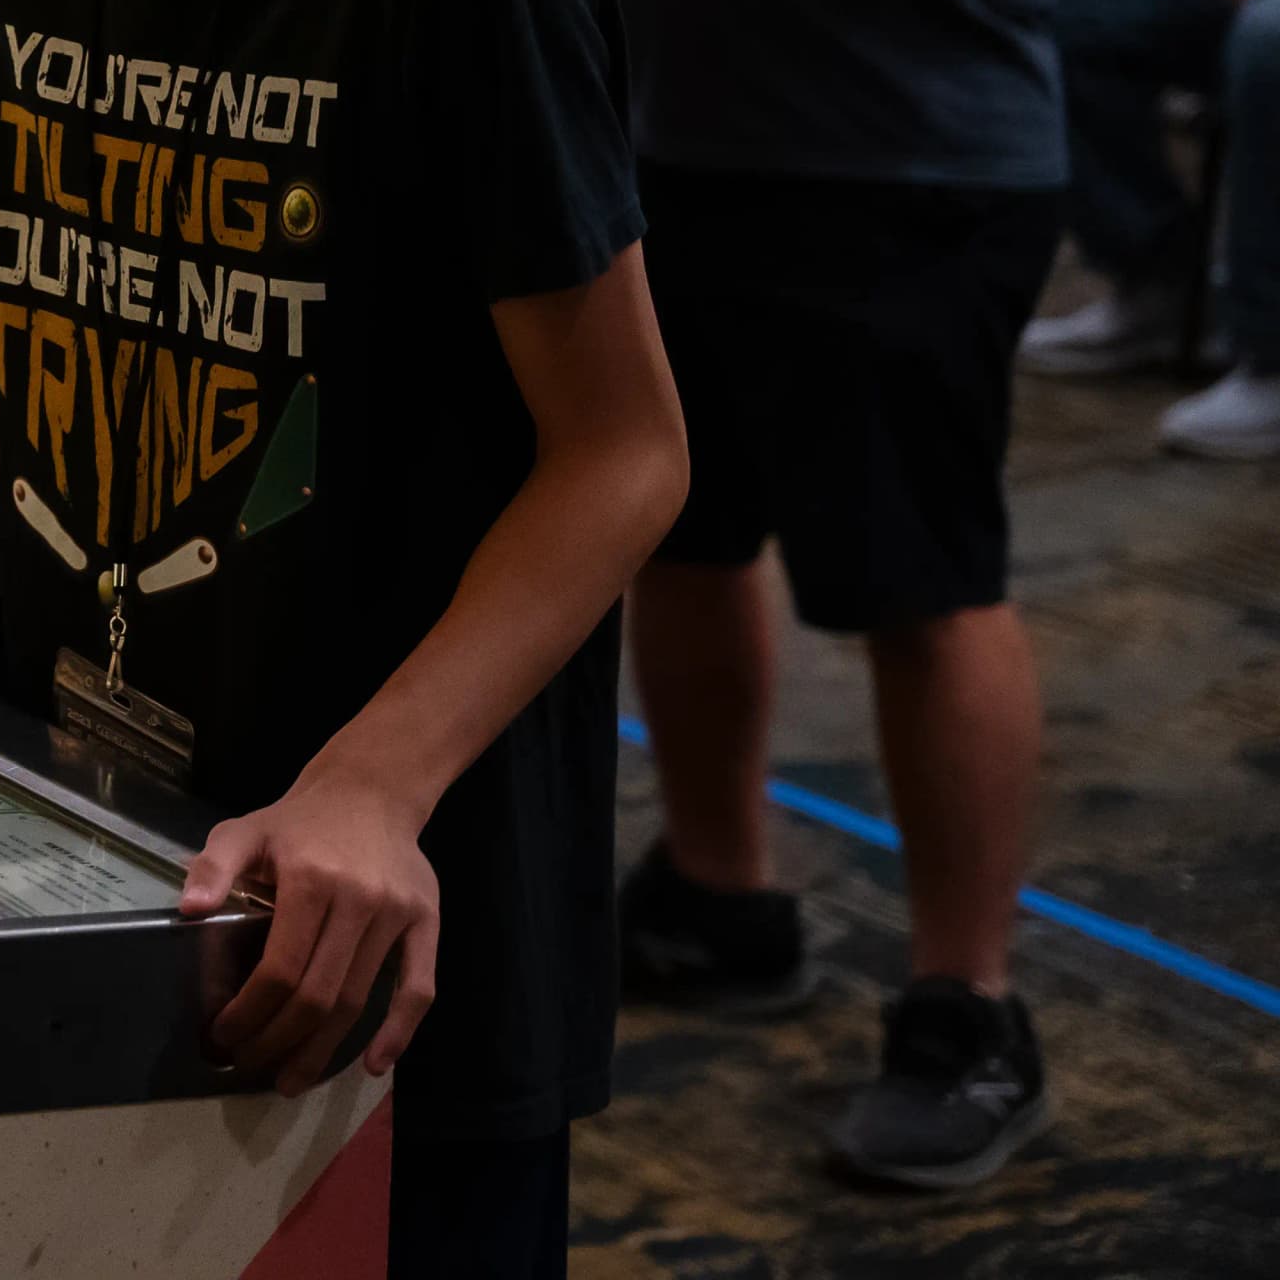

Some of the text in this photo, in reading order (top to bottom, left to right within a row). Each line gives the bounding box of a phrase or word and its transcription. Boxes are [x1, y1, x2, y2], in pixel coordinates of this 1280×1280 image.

[4, 24, 208, 132] YOU'RE
[206, 71, 338, 148] NOT
[0, 100, 269, 252] TILTING
[177, 260, 326, 357] NOT
